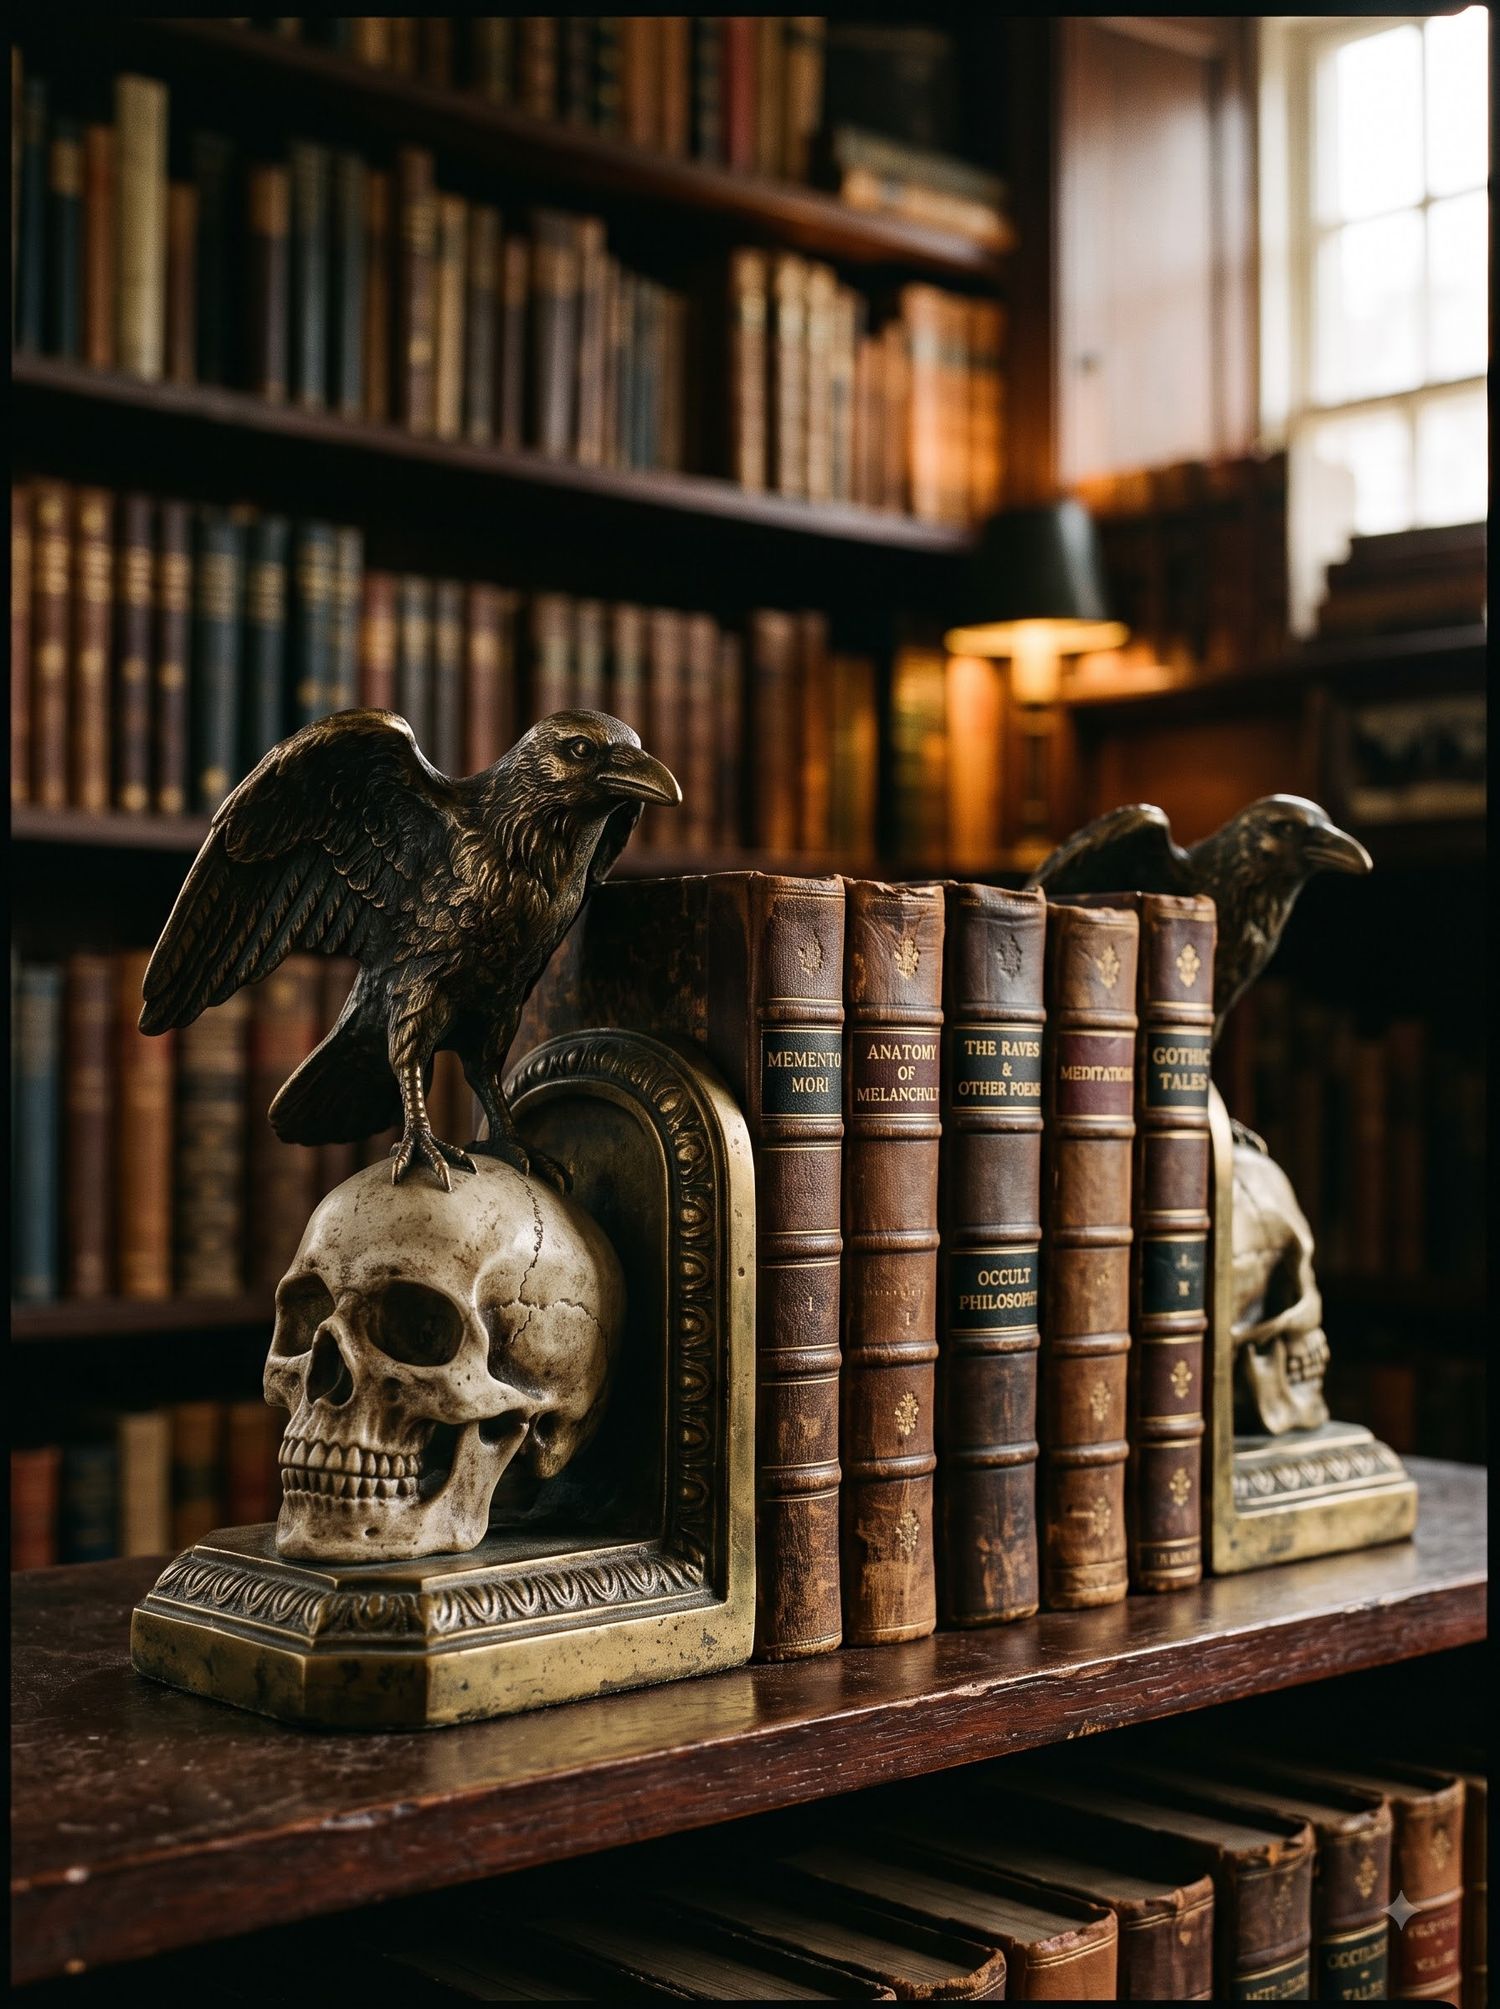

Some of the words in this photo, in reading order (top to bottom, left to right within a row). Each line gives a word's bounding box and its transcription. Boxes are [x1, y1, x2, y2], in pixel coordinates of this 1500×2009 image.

[867, 1044, 937, 1060] ANATOMY
[964, 1040, 997, 1056] THE
[1001, 1041, 1040, 1057] RAVES
[1153, 1047, 1211, 1067] GOTHIC
[768, 1051, 841, 1068] MEMENTO
[897, 1066, 916, 1081] OF
[1002, 1062, 1013, 1077] &
[792, 1076, 829, 1093] MORI
[958, 1081, 1008, 1097] OTHER
[1159, 1073, 1208, 1091] TALES
[978, 1267, 1032, 1286] OCCULT
